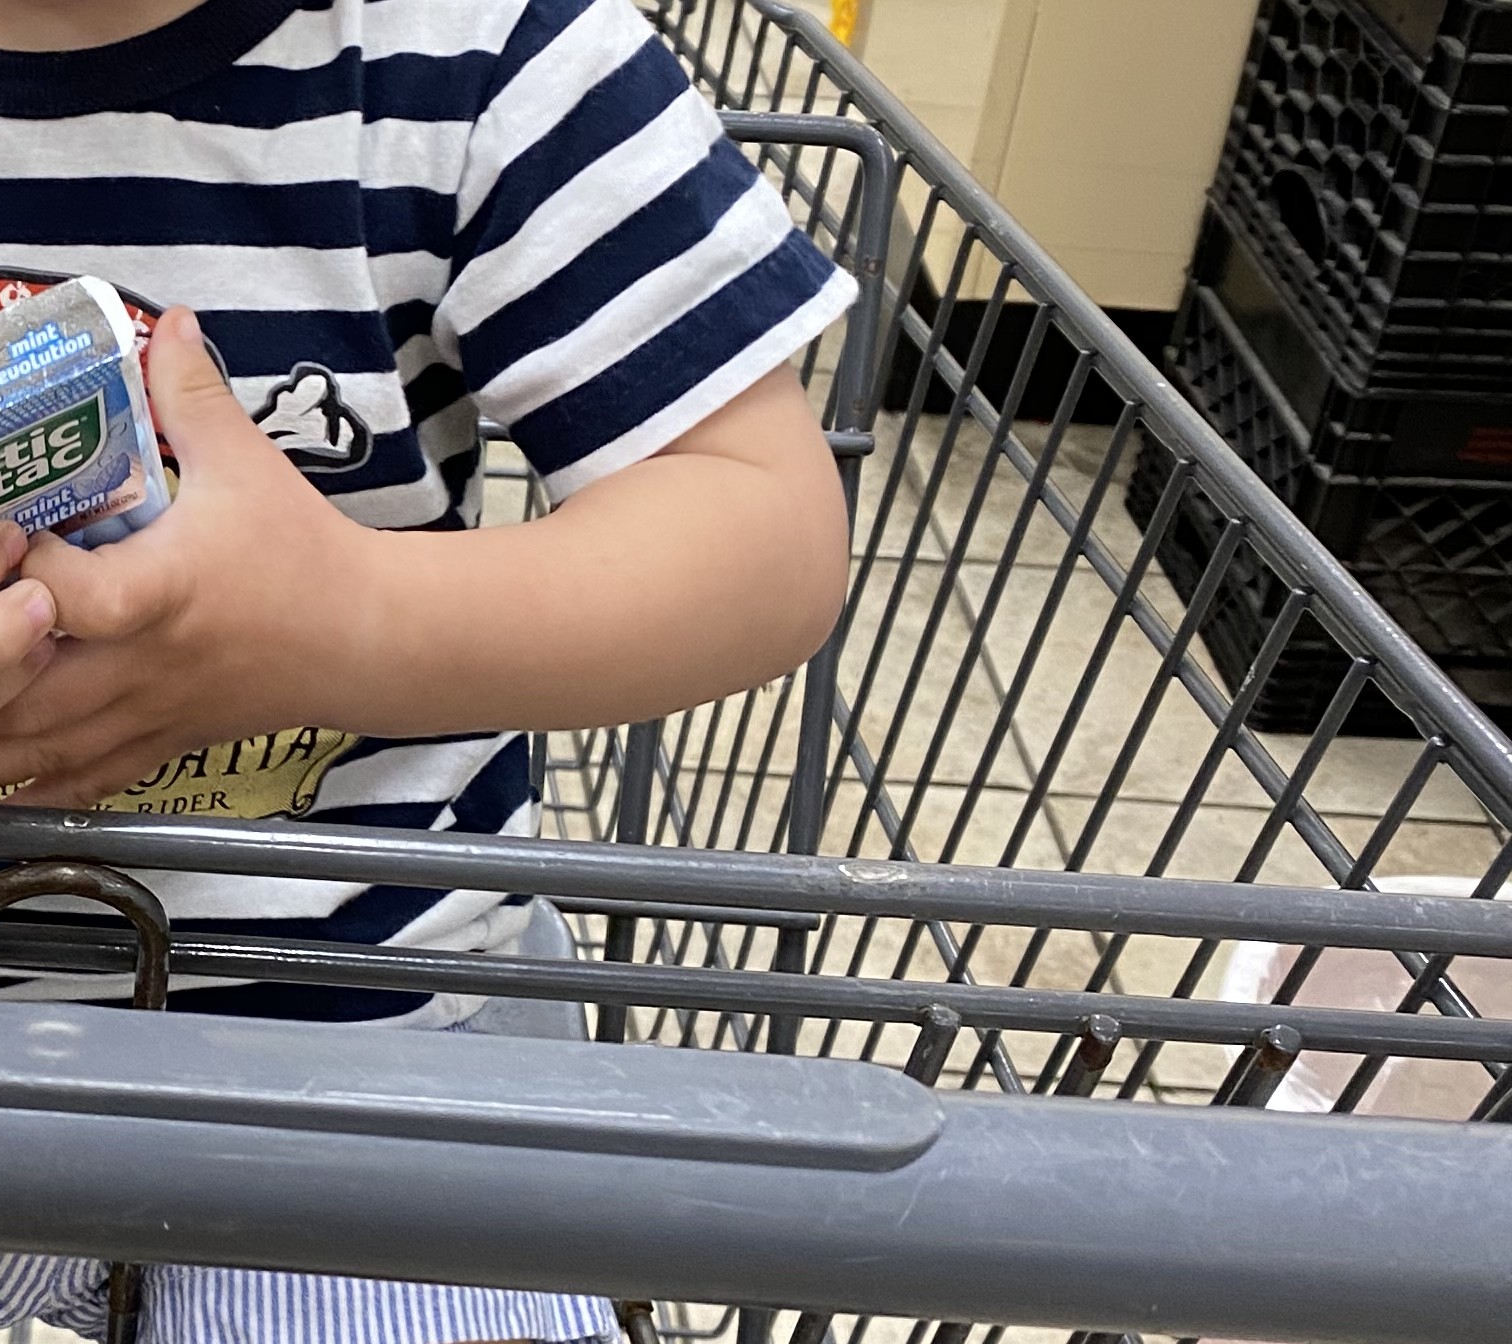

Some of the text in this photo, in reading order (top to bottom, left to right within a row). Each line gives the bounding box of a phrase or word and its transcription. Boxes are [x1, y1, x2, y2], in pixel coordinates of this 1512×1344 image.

[11, 322, 60, 359] mint
[0, 418, 82, 469] tic
[16, 486, 74, 523] mint
[22, 491, 107, 535] olution
